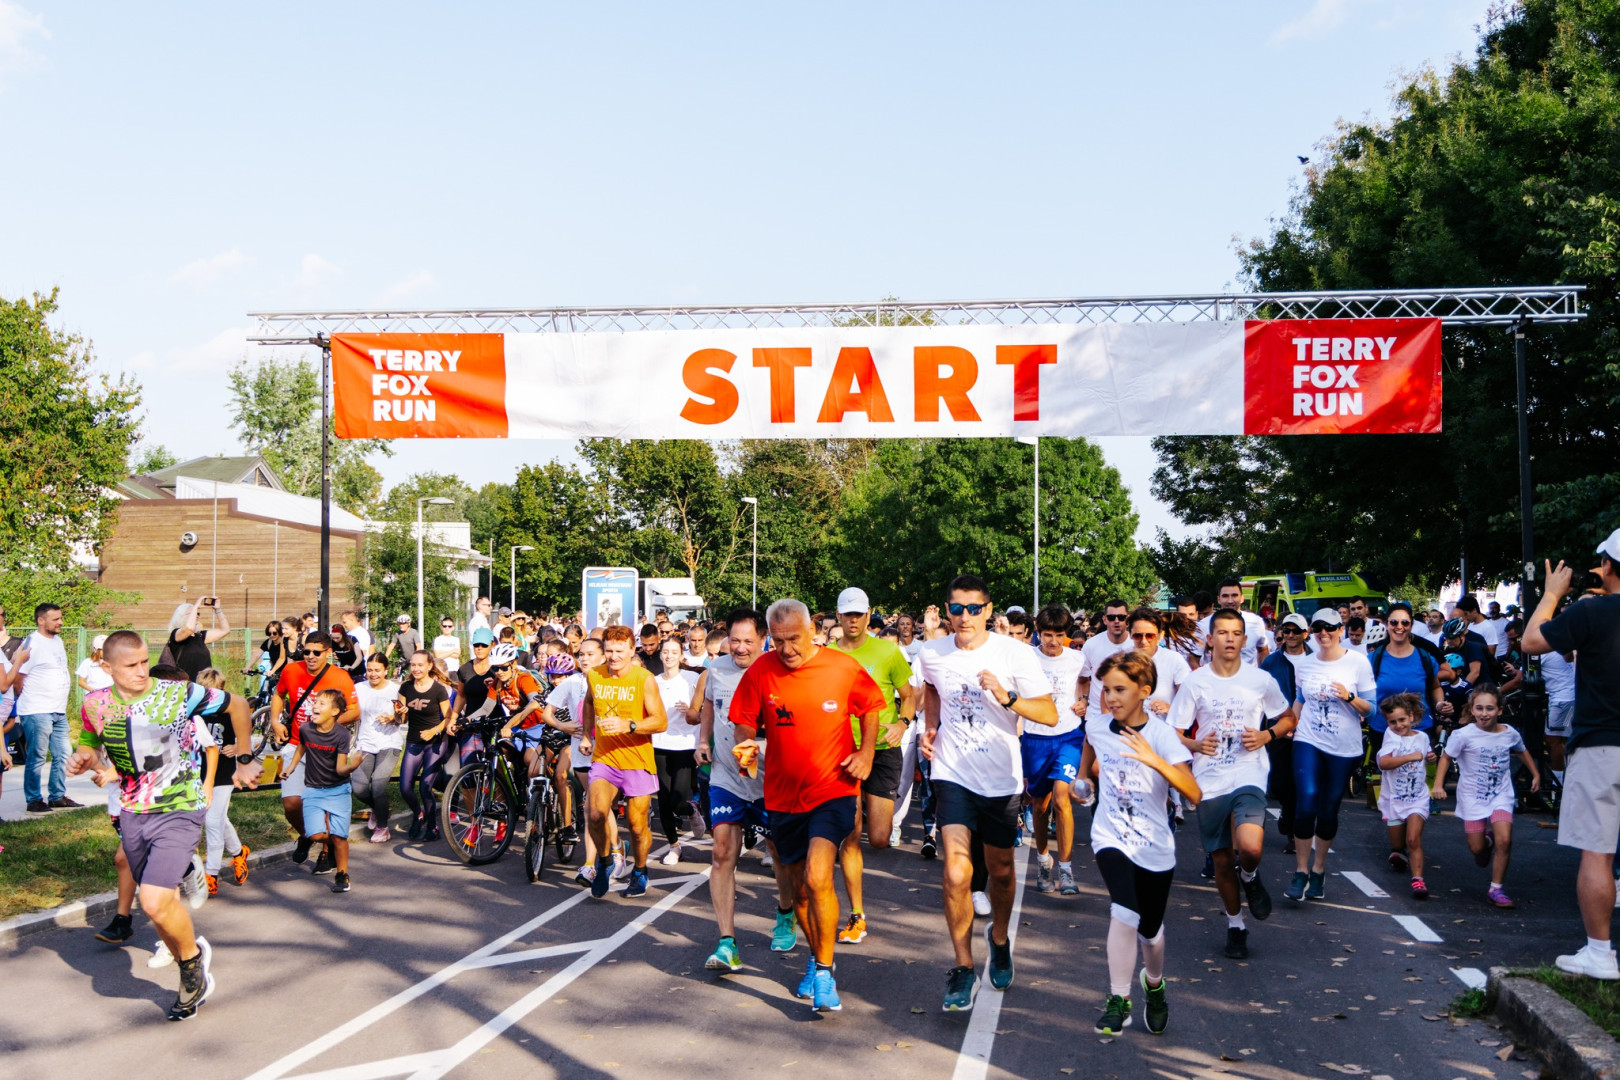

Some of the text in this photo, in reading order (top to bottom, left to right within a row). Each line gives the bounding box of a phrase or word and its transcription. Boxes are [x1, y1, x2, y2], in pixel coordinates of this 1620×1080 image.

[1292, 336, 1398, 361] TERRY
[368, 349, 462, 372] TERRY
[372, 374, 432, 396] FOX
[679, 344, 1058, 426] START
[1293, 364, 1360, 389] FOX
[373, 399, 436, 422] RUN
[1293, 392, 1363, 417] RUN
[594, 683, 636, 702] SURFING
[1103, 753, 1121, 765] Dear
[1062, 763, 1076, 780] 12
